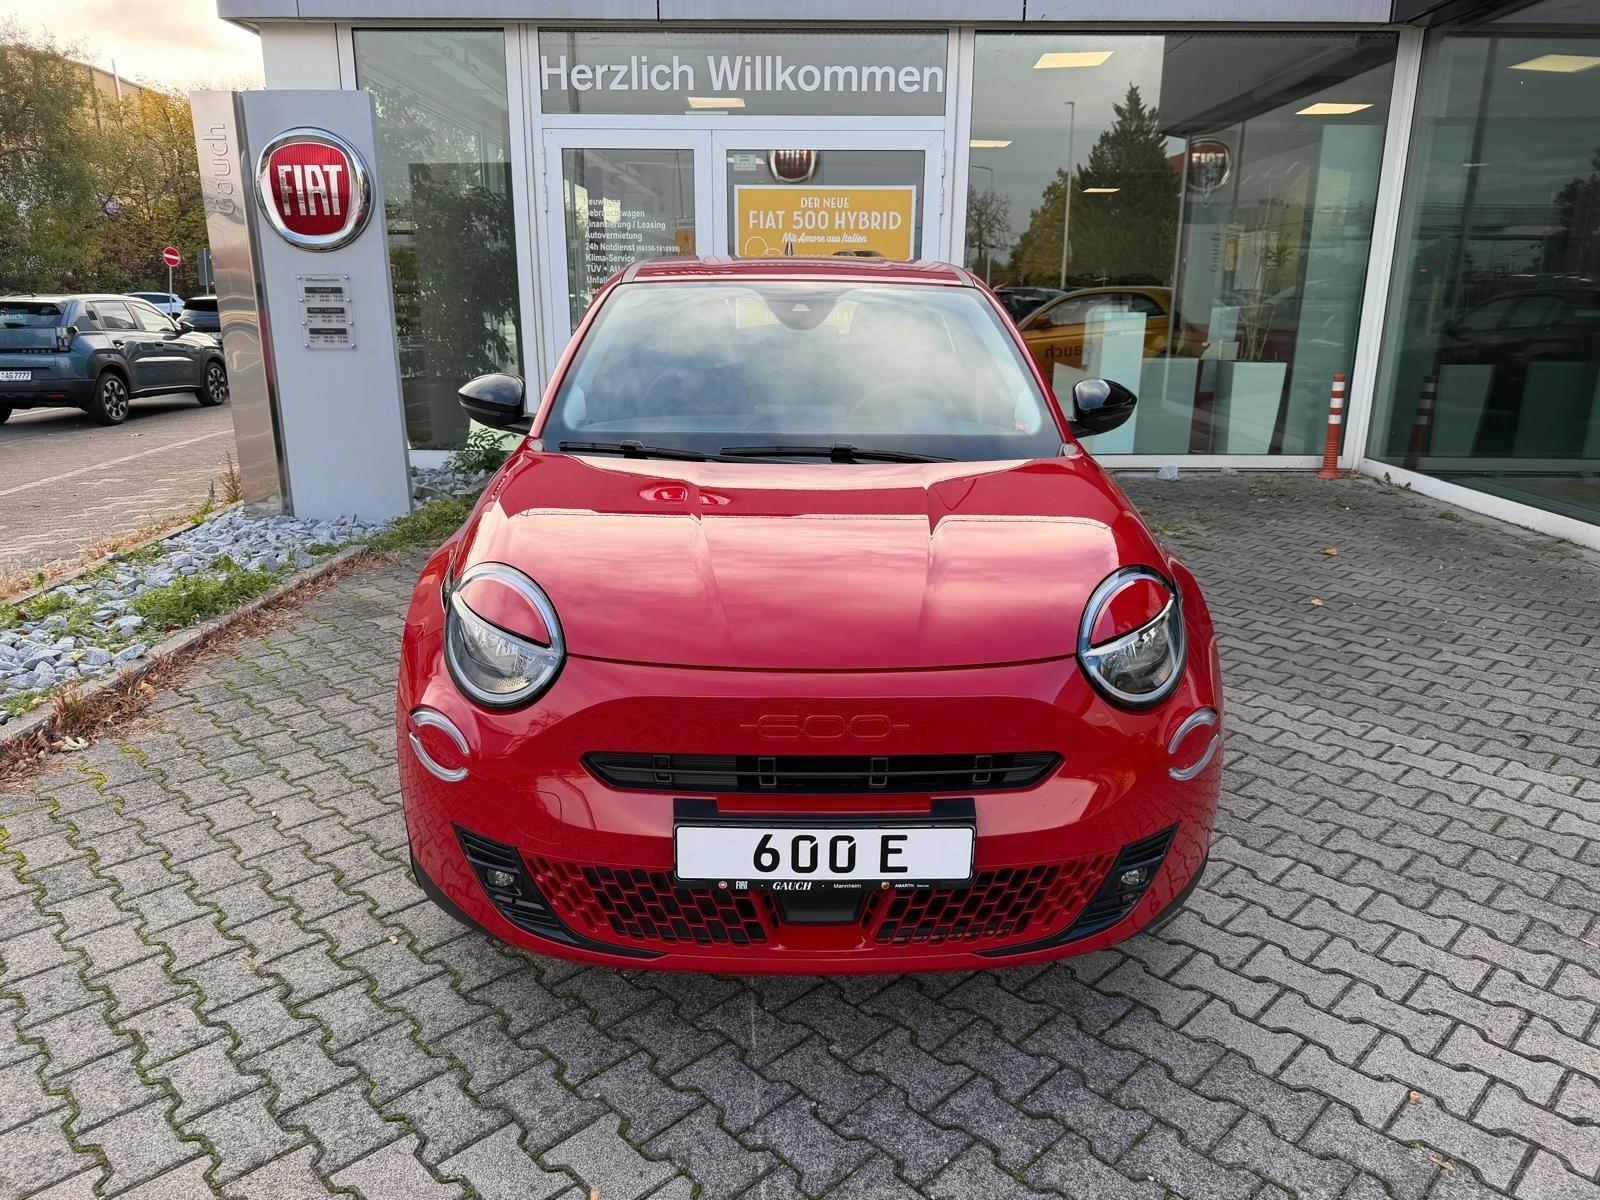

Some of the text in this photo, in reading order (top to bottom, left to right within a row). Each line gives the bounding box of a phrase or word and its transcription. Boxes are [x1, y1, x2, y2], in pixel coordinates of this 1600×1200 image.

[541, 55, 944, 93] Herzlich Willkommen
[202, 123, 236, 216] Gauch
[277, 164, 343, 216] FIAT
[800, 196, 850, 208] DER NEUE
[637, 221, 666, 230] Leasing
[748, 210, 902, 229] FIAT 500 HYBRID
[585, 231, 643, 241] Autovermietung
[781, 232, 868, 244] Mit Amore aus Italien
[585, 243, 598, 251] 24h
[600, 243, 635, 251] Notdienst
[586, 254, 636, 262] Klima-Service
[586, 263, 602, 272] TÜV
[752, 833, 908, 874] 600 E
[735, 880, 749, 890] FIAT
[772, 881, 813, 891] GAUCH
